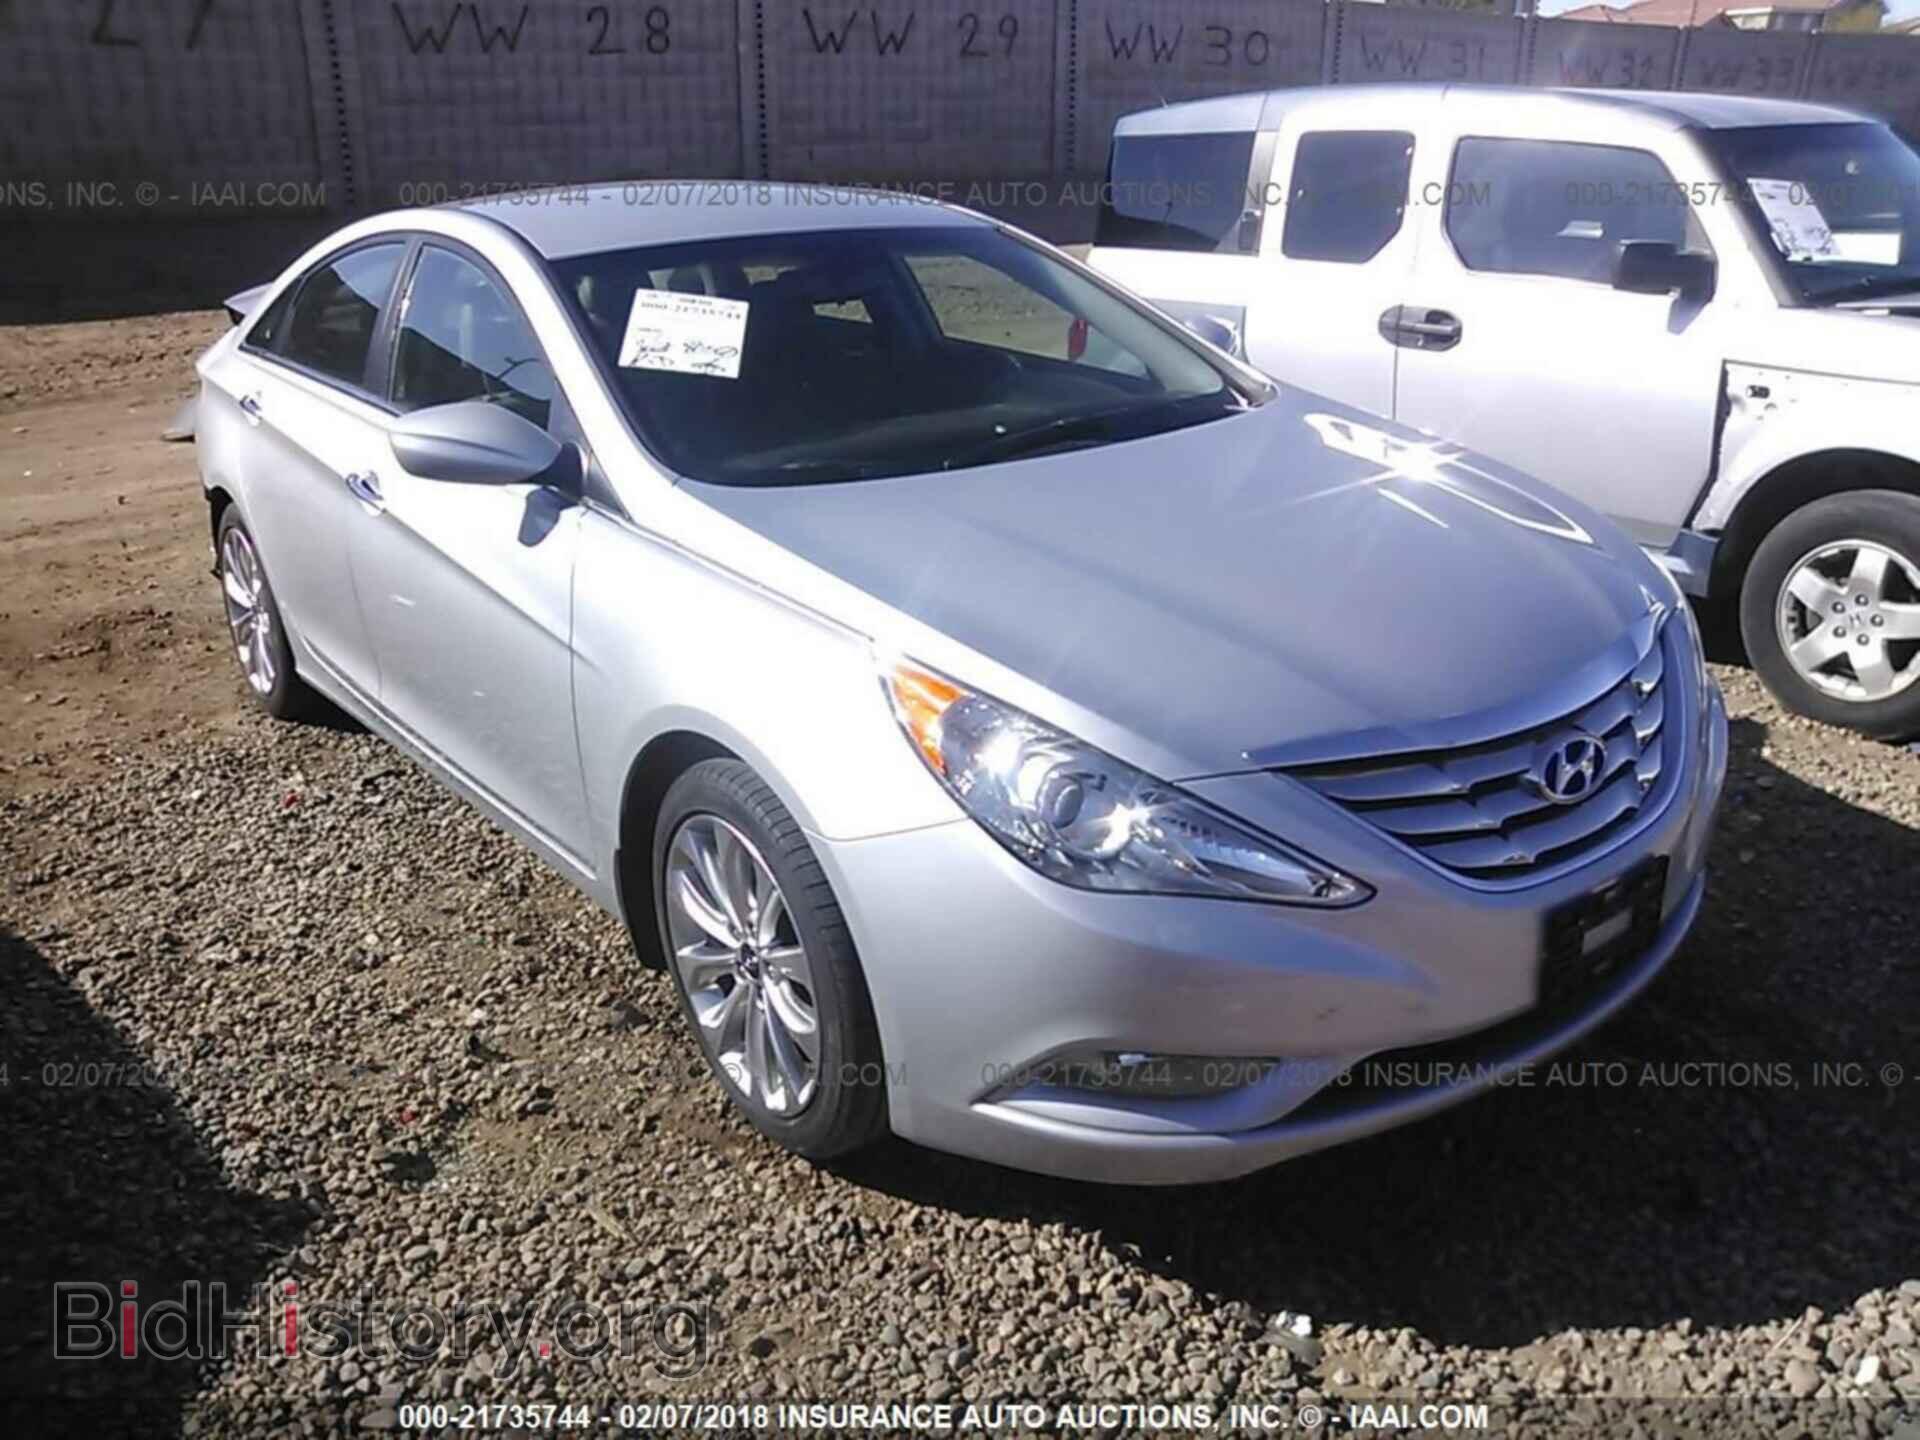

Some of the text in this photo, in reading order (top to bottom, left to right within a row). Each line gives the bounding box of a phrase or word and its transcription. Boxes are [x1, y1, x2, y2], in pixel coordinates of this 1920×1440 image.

[392, 3, 671, 55] WW 28
[803, 10, 1019, 57] WW 29
[1106, 21, 1270, 67] WW 30
[1450, 39, 1486, 80] 31
